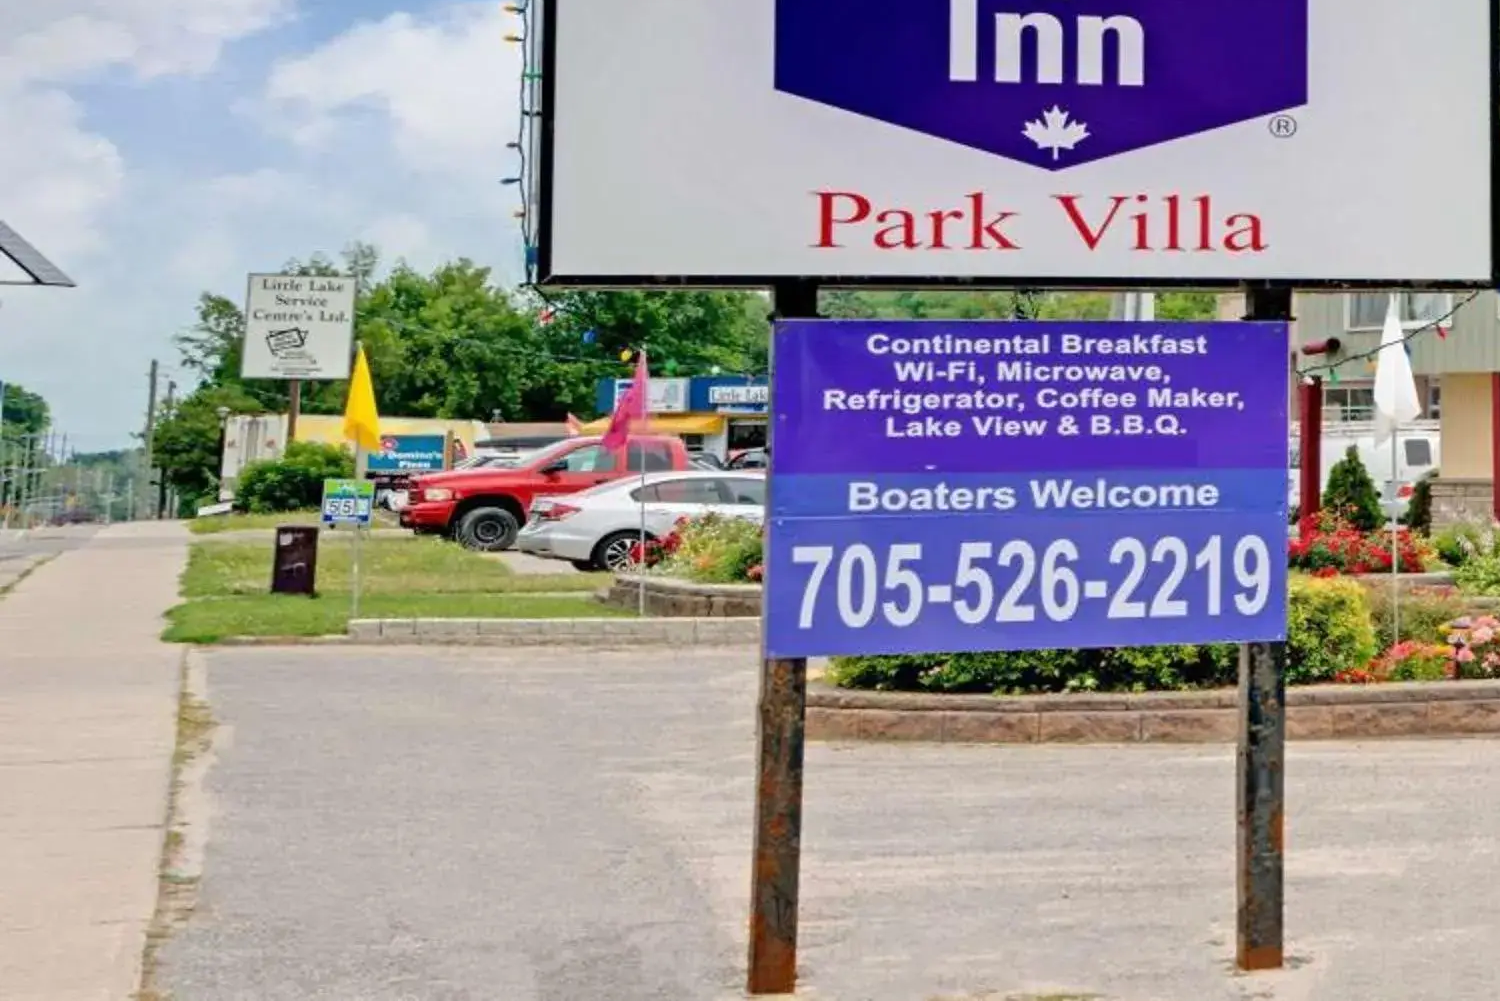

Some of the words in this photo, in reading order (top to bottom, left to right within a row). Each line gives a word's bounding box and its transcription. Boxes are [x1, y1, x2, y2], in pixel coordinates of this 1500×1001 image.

[808, 191, 1022, 251] Park
[1051, 193, 1269, 254] Villa
[262, 279, 302, 292] Little
[309, 280, 344, 292] Lake
[275, 294, 328, 307] Service
[253, 309, 313, 322] Centre's
[320, 310, 349, 324] Ltd.
[866, 333, 1050, 355] Continental
[1061, 334, 1207, 355] Breakfast
[894, 361, 985, 385] Wi-Fi,
[997, 361, 1171, 384] Microwave,
[823, 389, 1025, 413] Refrigerator,
[1036, 388, 1137, 409] Coffee
[1147, 387, 1245, 410] Maker,
[886, 416, 962, 438] Lake
[971, 416, 1047, 437] View
[1057, 415, 1079, 436] &
[1091, 414, 1187, 437] B.B.Q.
[848, 481, 1017, 512] Boaters
[1029, 479, 1220, 509] Welcome
[791, 534, 1271, 629] 705-526-2219
